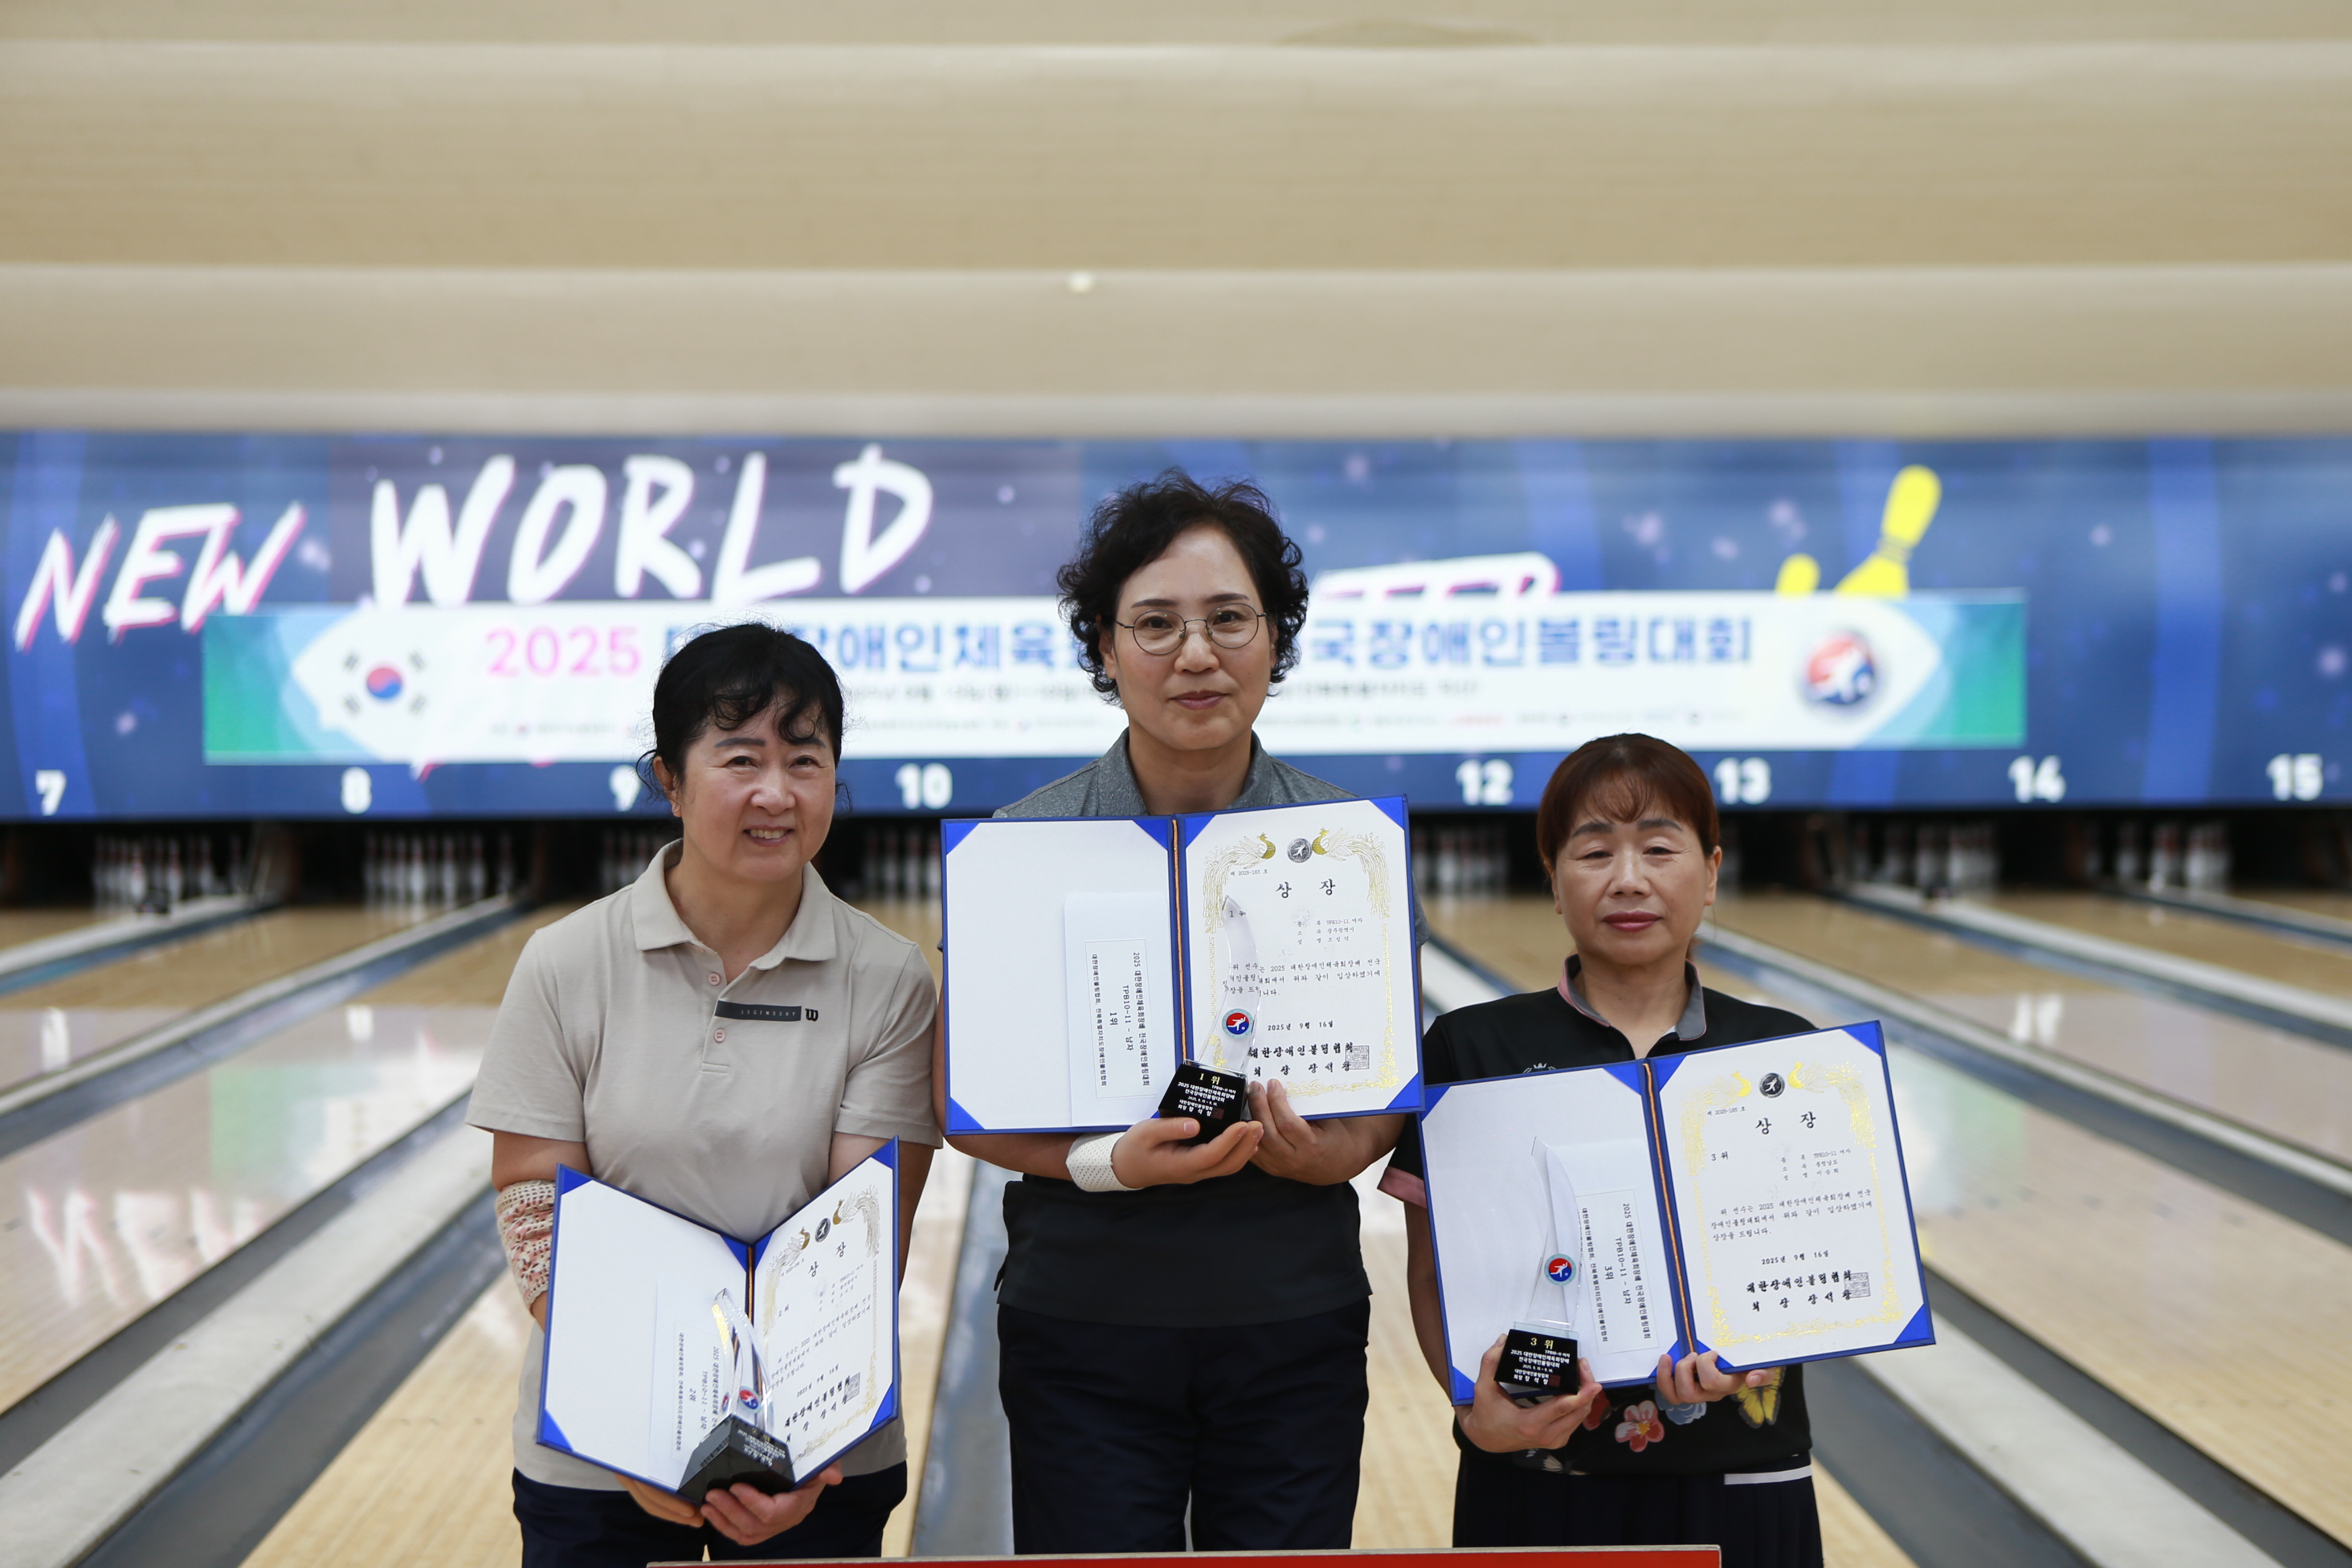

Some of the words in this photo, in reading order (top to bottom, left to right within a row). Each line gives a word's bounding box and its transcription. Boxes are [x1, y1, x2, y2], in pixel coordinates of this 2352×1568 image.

[14, 500, 308, 652] NEW
[371, 444, 934, 607] WORLD
[485, 627, 642, 677] 2025
[894, 764, 953, 810] 10
[1456, 758, 1514, 806] 12
[1714, 756, 1772, 804] 13
[2008, 755, 2066, 803] 14
[2266, 753, 2324, 801] 15
[35, 769, 67, 816] 7
[340, 766, 373, 814] 8
[1276, 881, 1292, 898] 상
[1319, 878, 1336, 895] 장
[1367, 958, 1380, 966] 전국
[1315, 973, 1328, 981] 같이
[1122, 985, 1132, 1024] TPB10~11
[1110, 1012, 1118, 1025] 1위
[1267, 1023, 1291, 1031] 2025년
[1125, 1037, 1134, 1051] 남자
[1211, 1076, 1220, 1085] 위
[1755, 1117, 1772, 1135] 상
[1800, 1111, 1817, 1129] 장
[1623, 1203, 1631, 1219] 2025
[807, 1261, 819, 1277] 상
[836, 1242, 846, 1257] 장
[1761, 1256, 1786, 1265] 2025년
[1605, 1266, 1614, 1280] 3위
[1623, 1290, 1632, 1304] 남자
[1530, 1337, 1537, 1345] 3
[1545, 1339, 1554, 1350] 위
